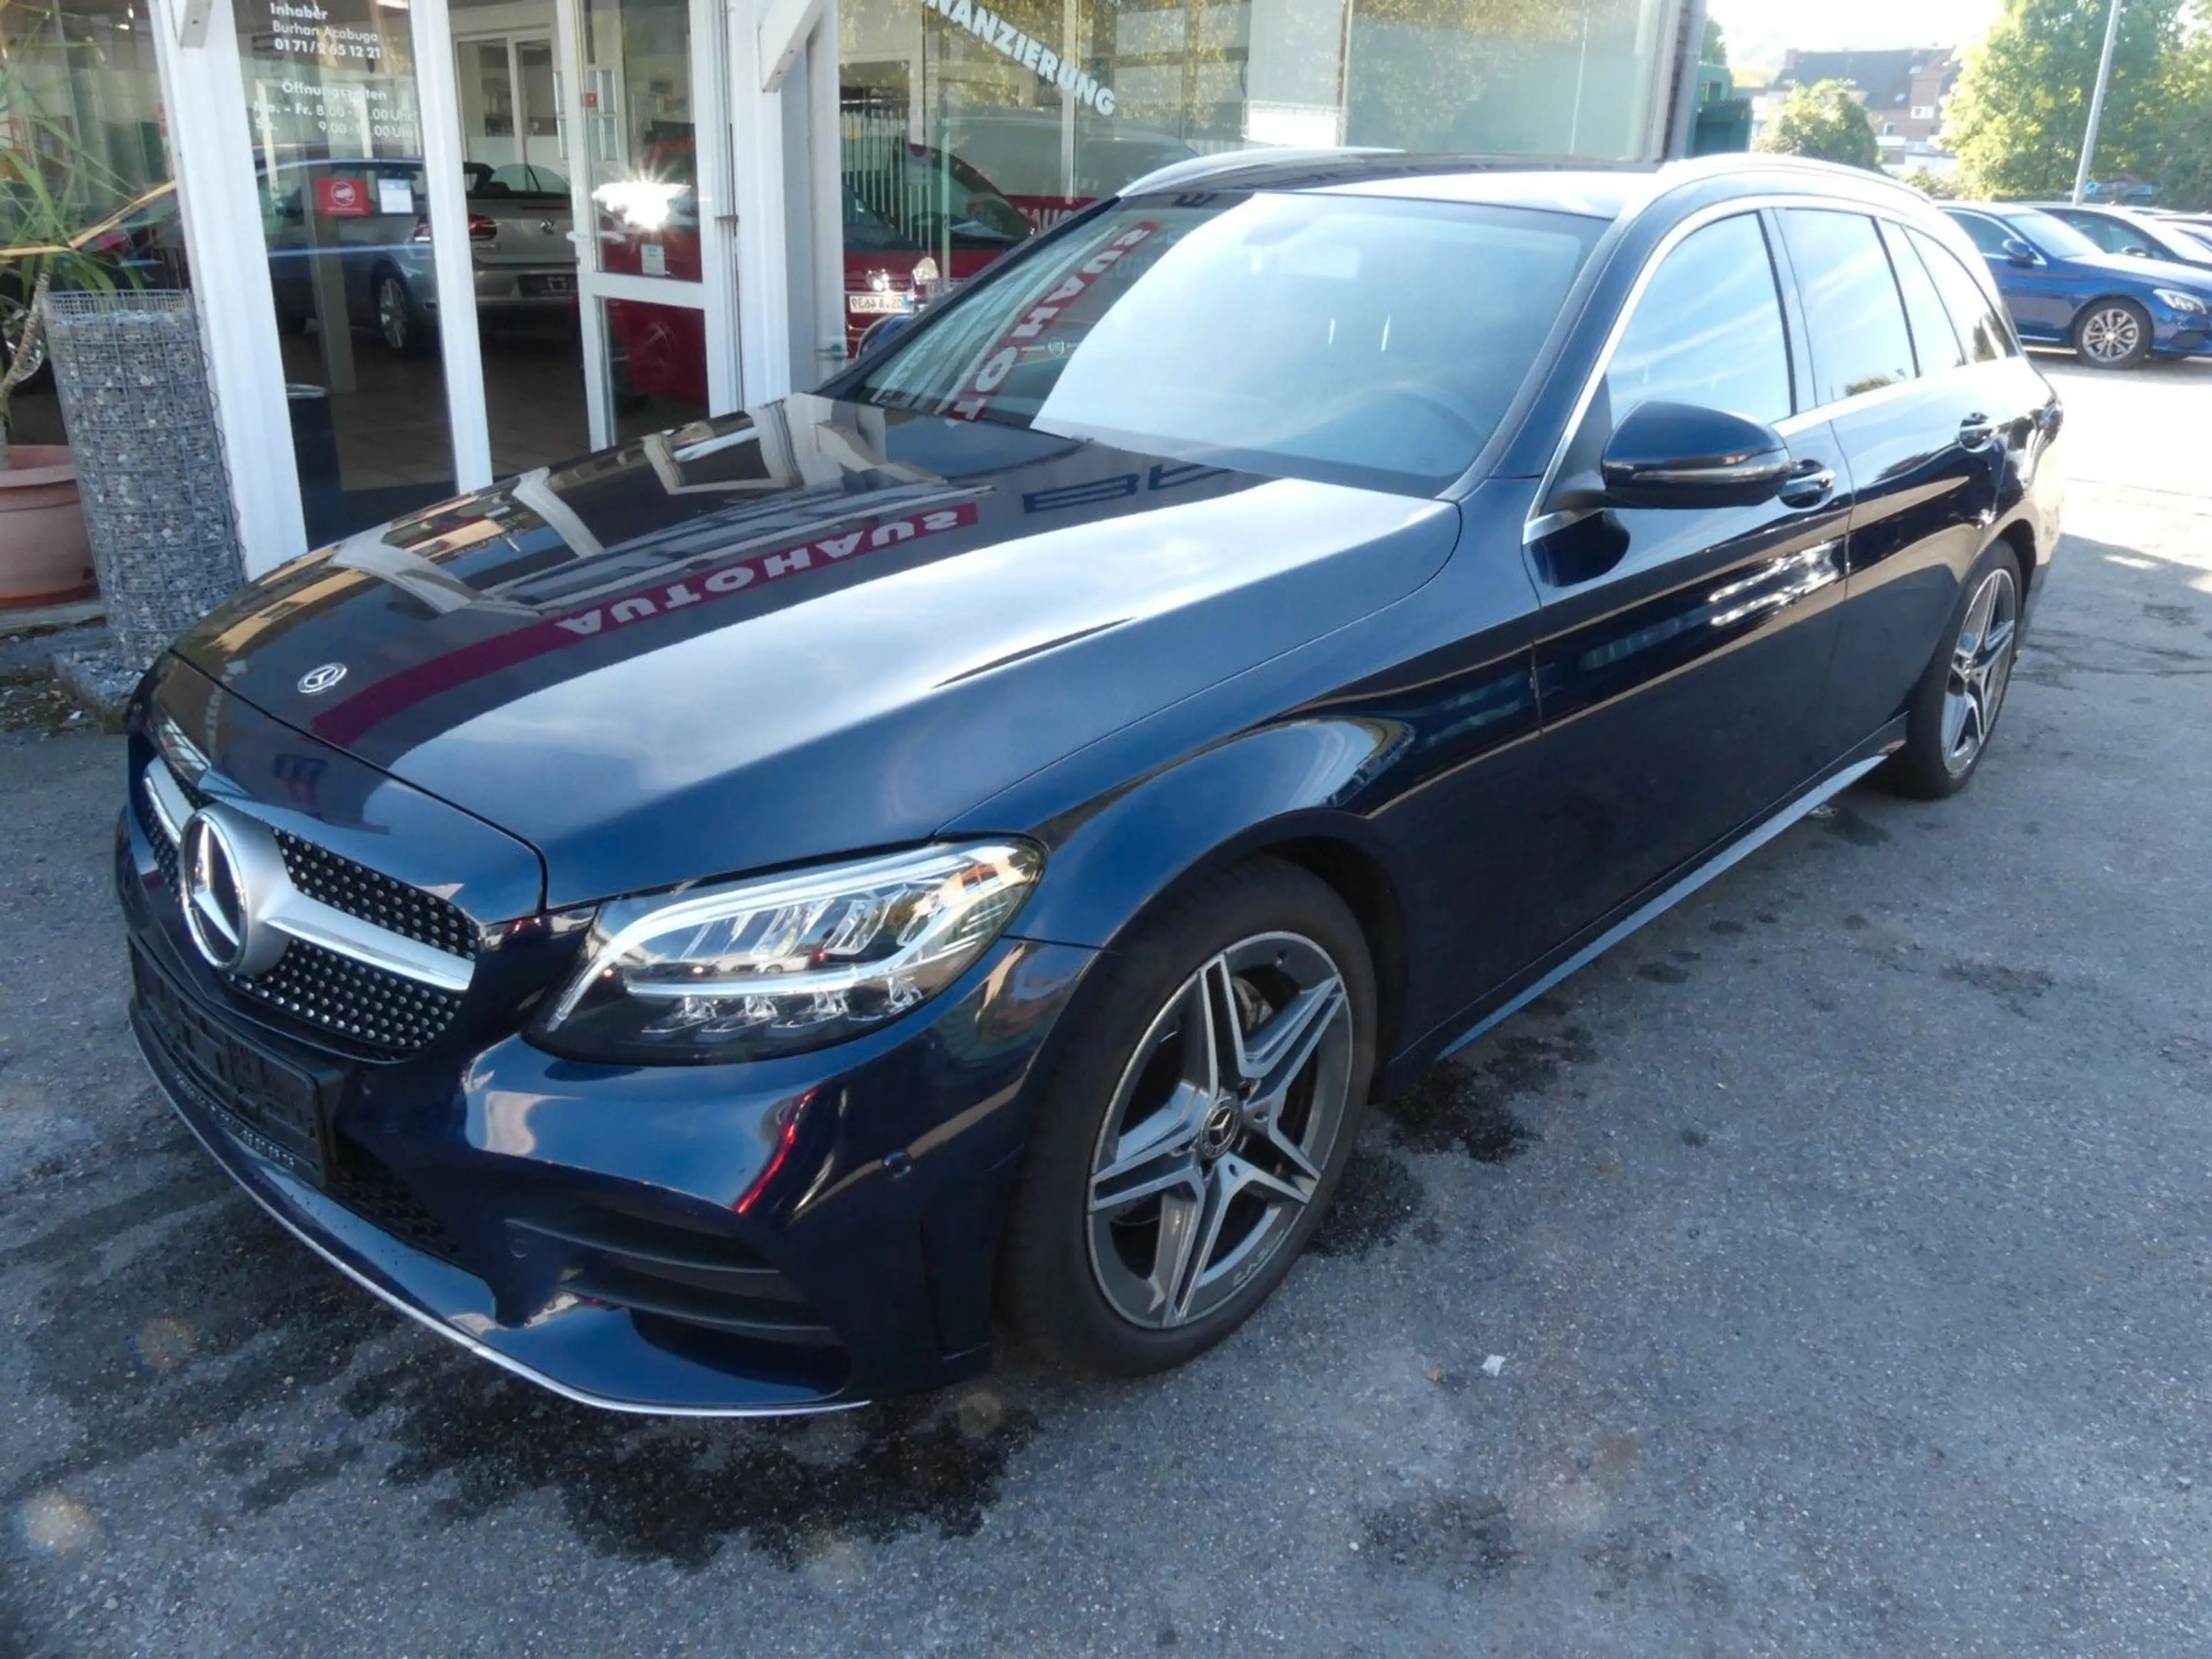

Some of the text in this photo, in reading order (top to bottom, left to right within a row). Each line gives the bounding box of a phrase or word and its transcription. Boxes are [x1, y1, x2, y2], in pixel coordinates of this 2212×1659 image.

[270, 2, 328, 20] Inhaber
[272, 20, 320, 36] Burhan
[282, 79, 387, 100] Öffnungszten
